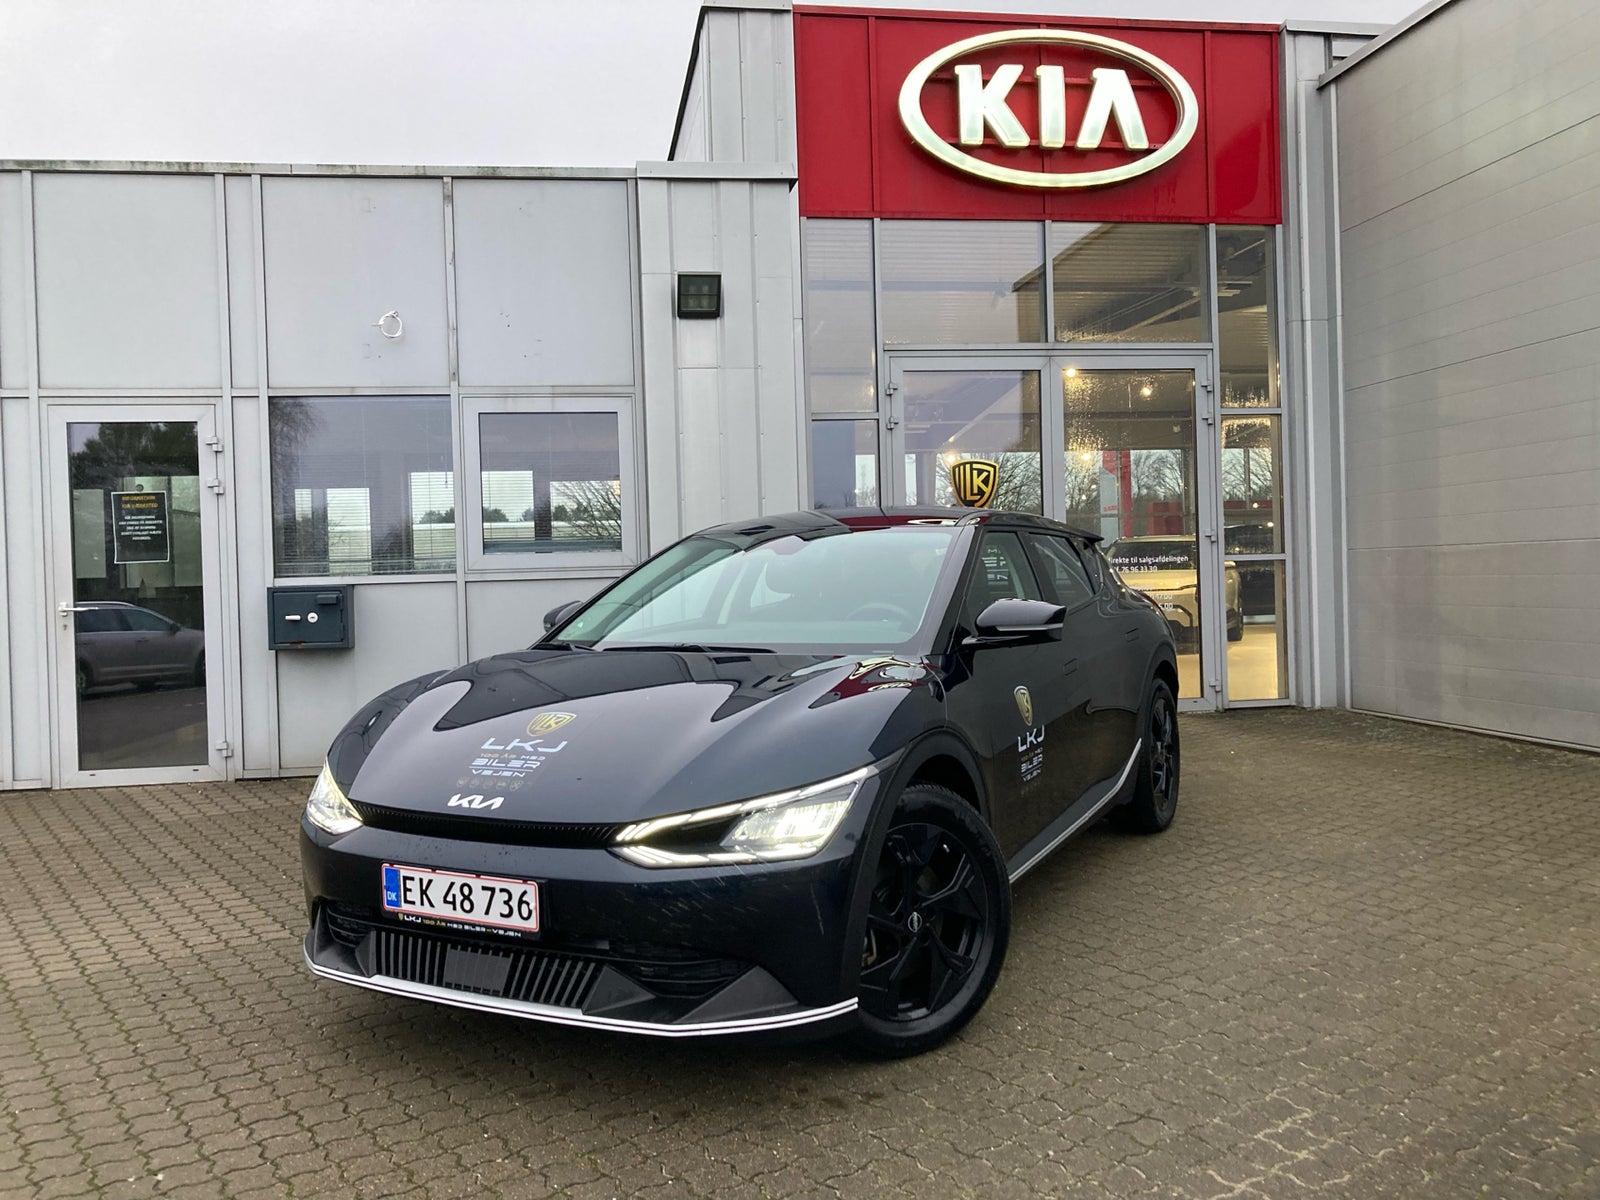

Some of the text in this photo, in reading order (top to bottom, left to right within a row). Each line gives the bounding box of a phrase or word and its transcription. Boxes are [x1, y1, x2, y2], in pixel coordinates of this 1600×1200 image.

[953, 63, 1150, 150] KIA
[481, 737, 568, 753] LKJ
[1017, 724, 1045, 753] LKJ
[472, 758, 541, 768] BILER
[387, 890, 398, 902] DK
[402, 875, 533, 921] EK 48 736
[404, 915, 421, 923] LKJ
